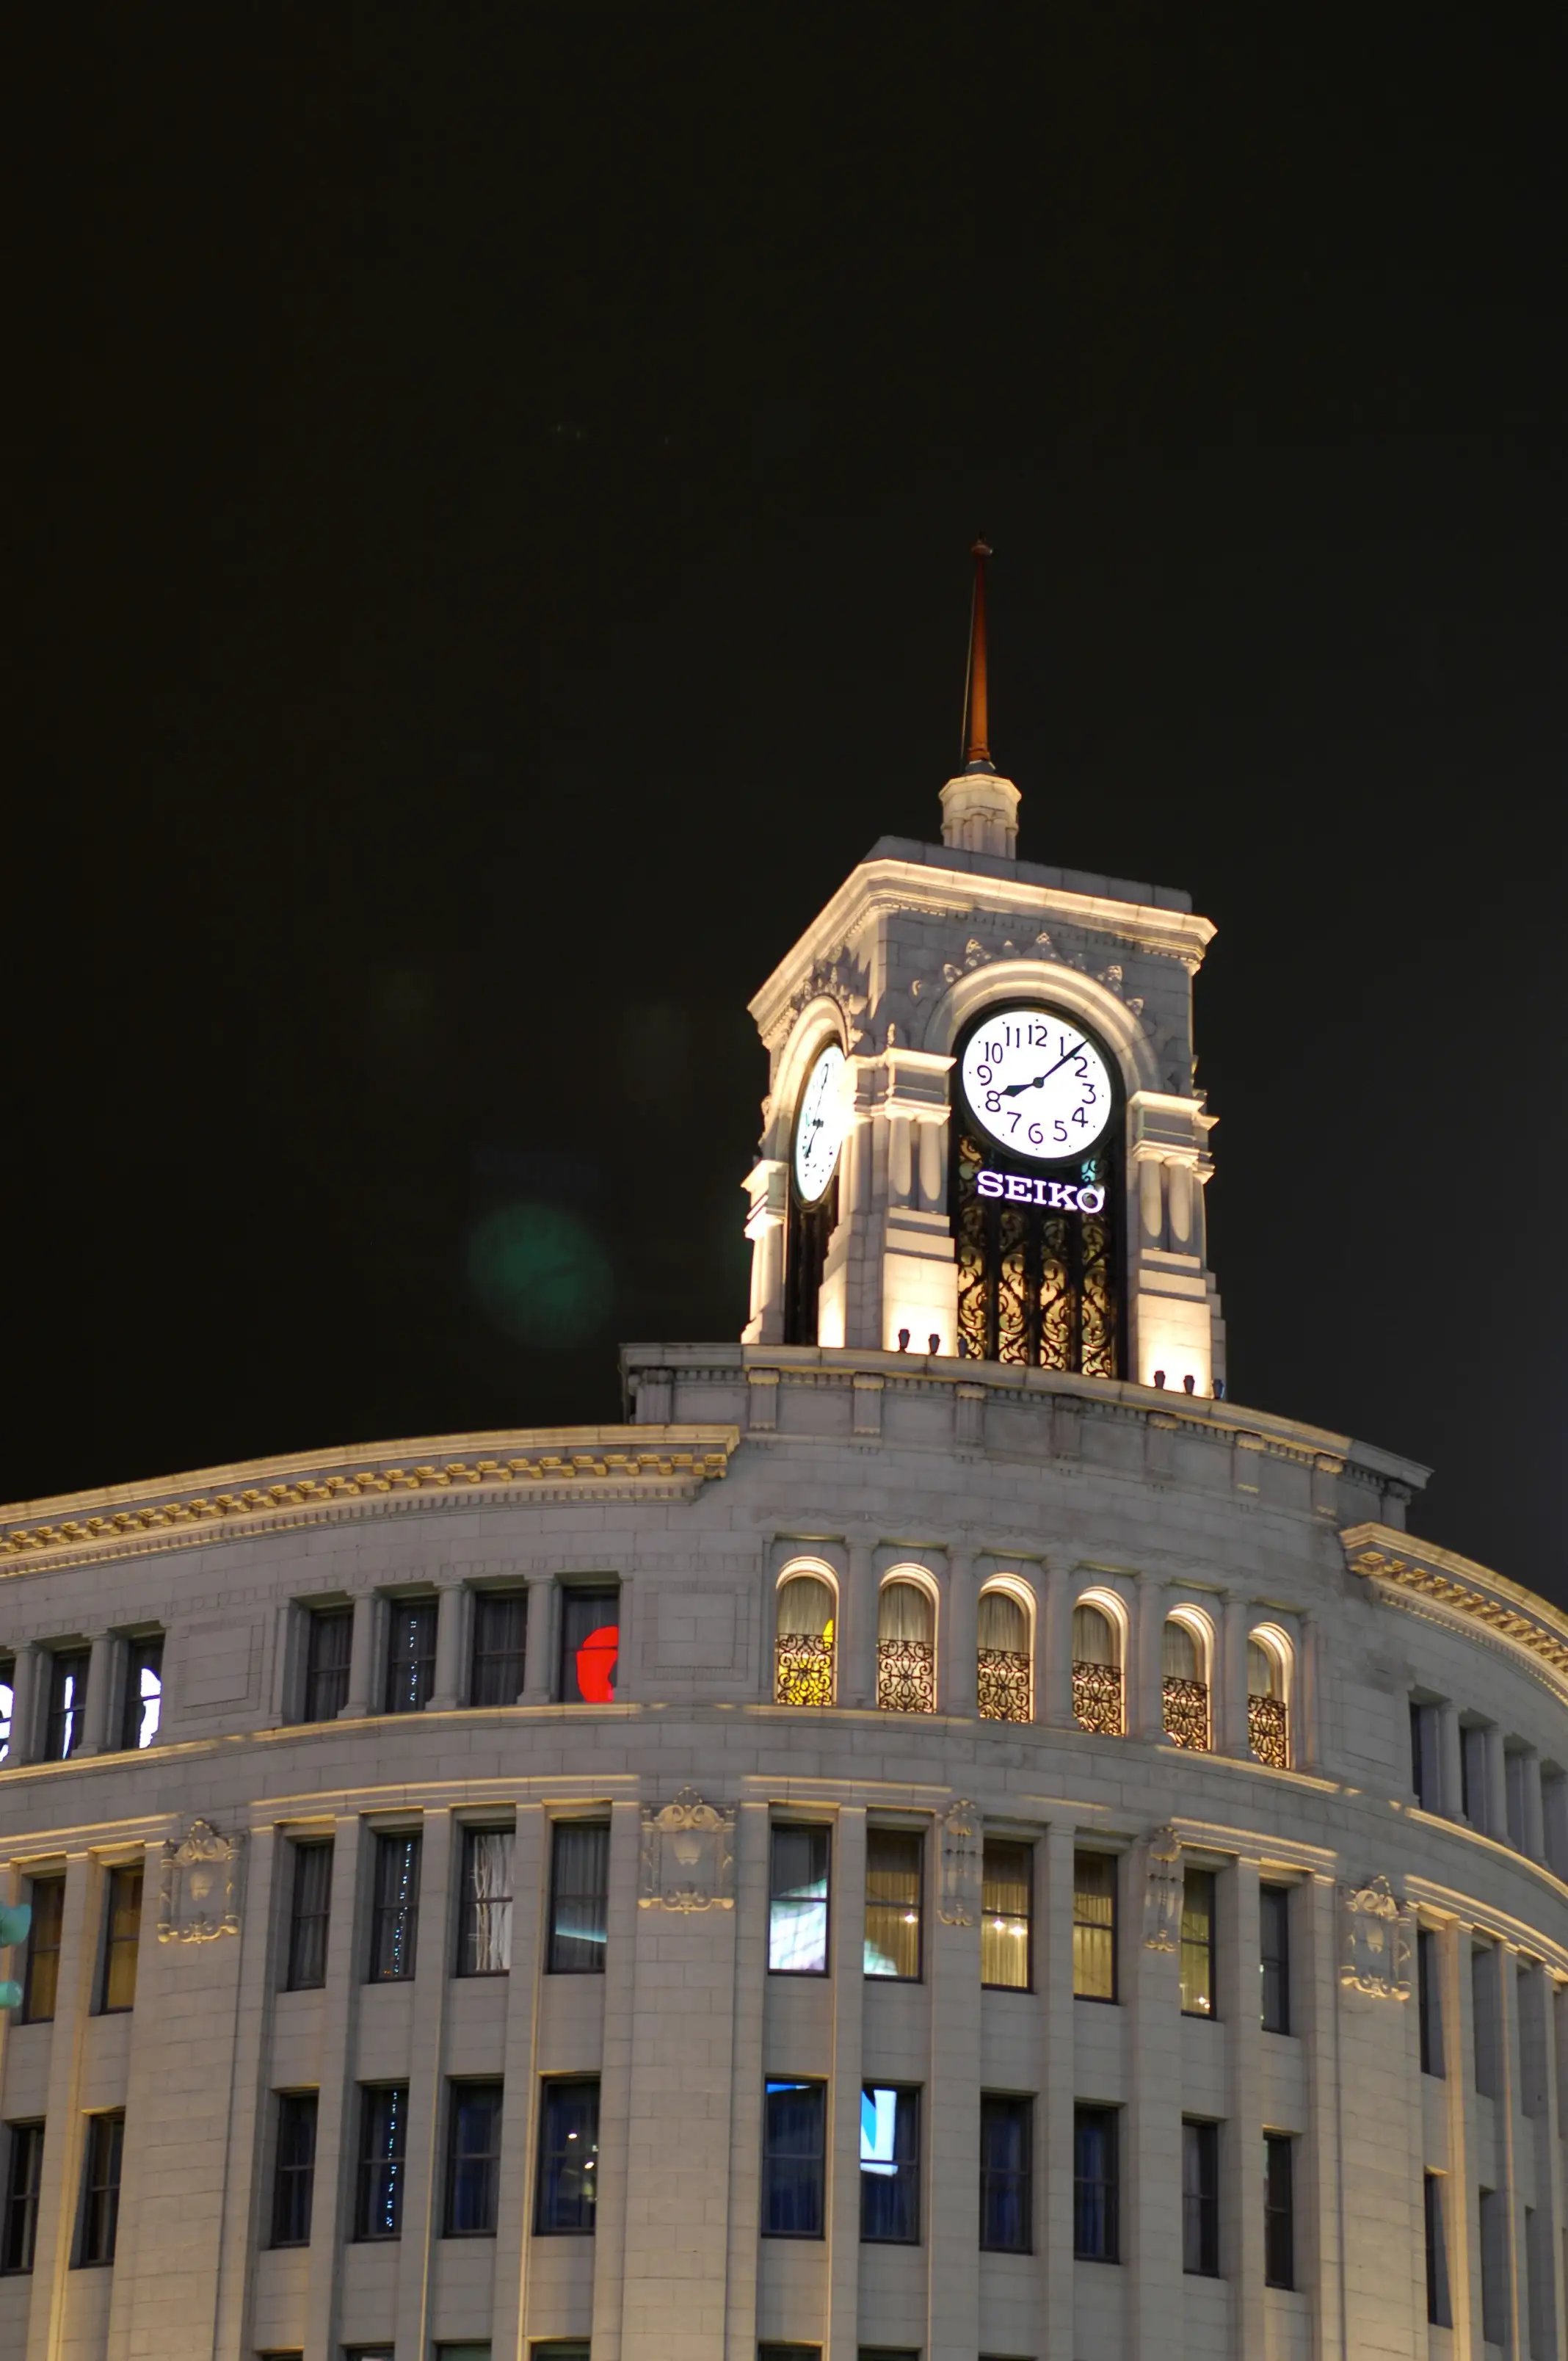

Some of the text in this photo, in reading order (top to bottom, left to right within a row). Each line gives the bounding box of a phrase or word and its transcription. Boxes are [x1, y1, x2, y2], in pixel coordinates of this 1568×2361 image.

[1006, 1026, 1020, 1048] 11
[1028, 1024, 1048, 1047] 12
[1059, 1036, 1065, 1056] 1
[985, 1042, 1003, 1064] 10
[977, 1065, 992, 1086] 9
[1073, 1056, 1088, 1078] 2
[985, 1090, 1001, 1112] 8
[1081, 1083, 1097, 1104] 3
[1006, 1111, 1022, 1133] 7
[1072, 1106, 1089, 1128] 4
[1028, 1123, 1043, 1145] 6
[1053, 1120, 1067, 1142] 5
[976, 1170, 1104, 1214] SEIKO
